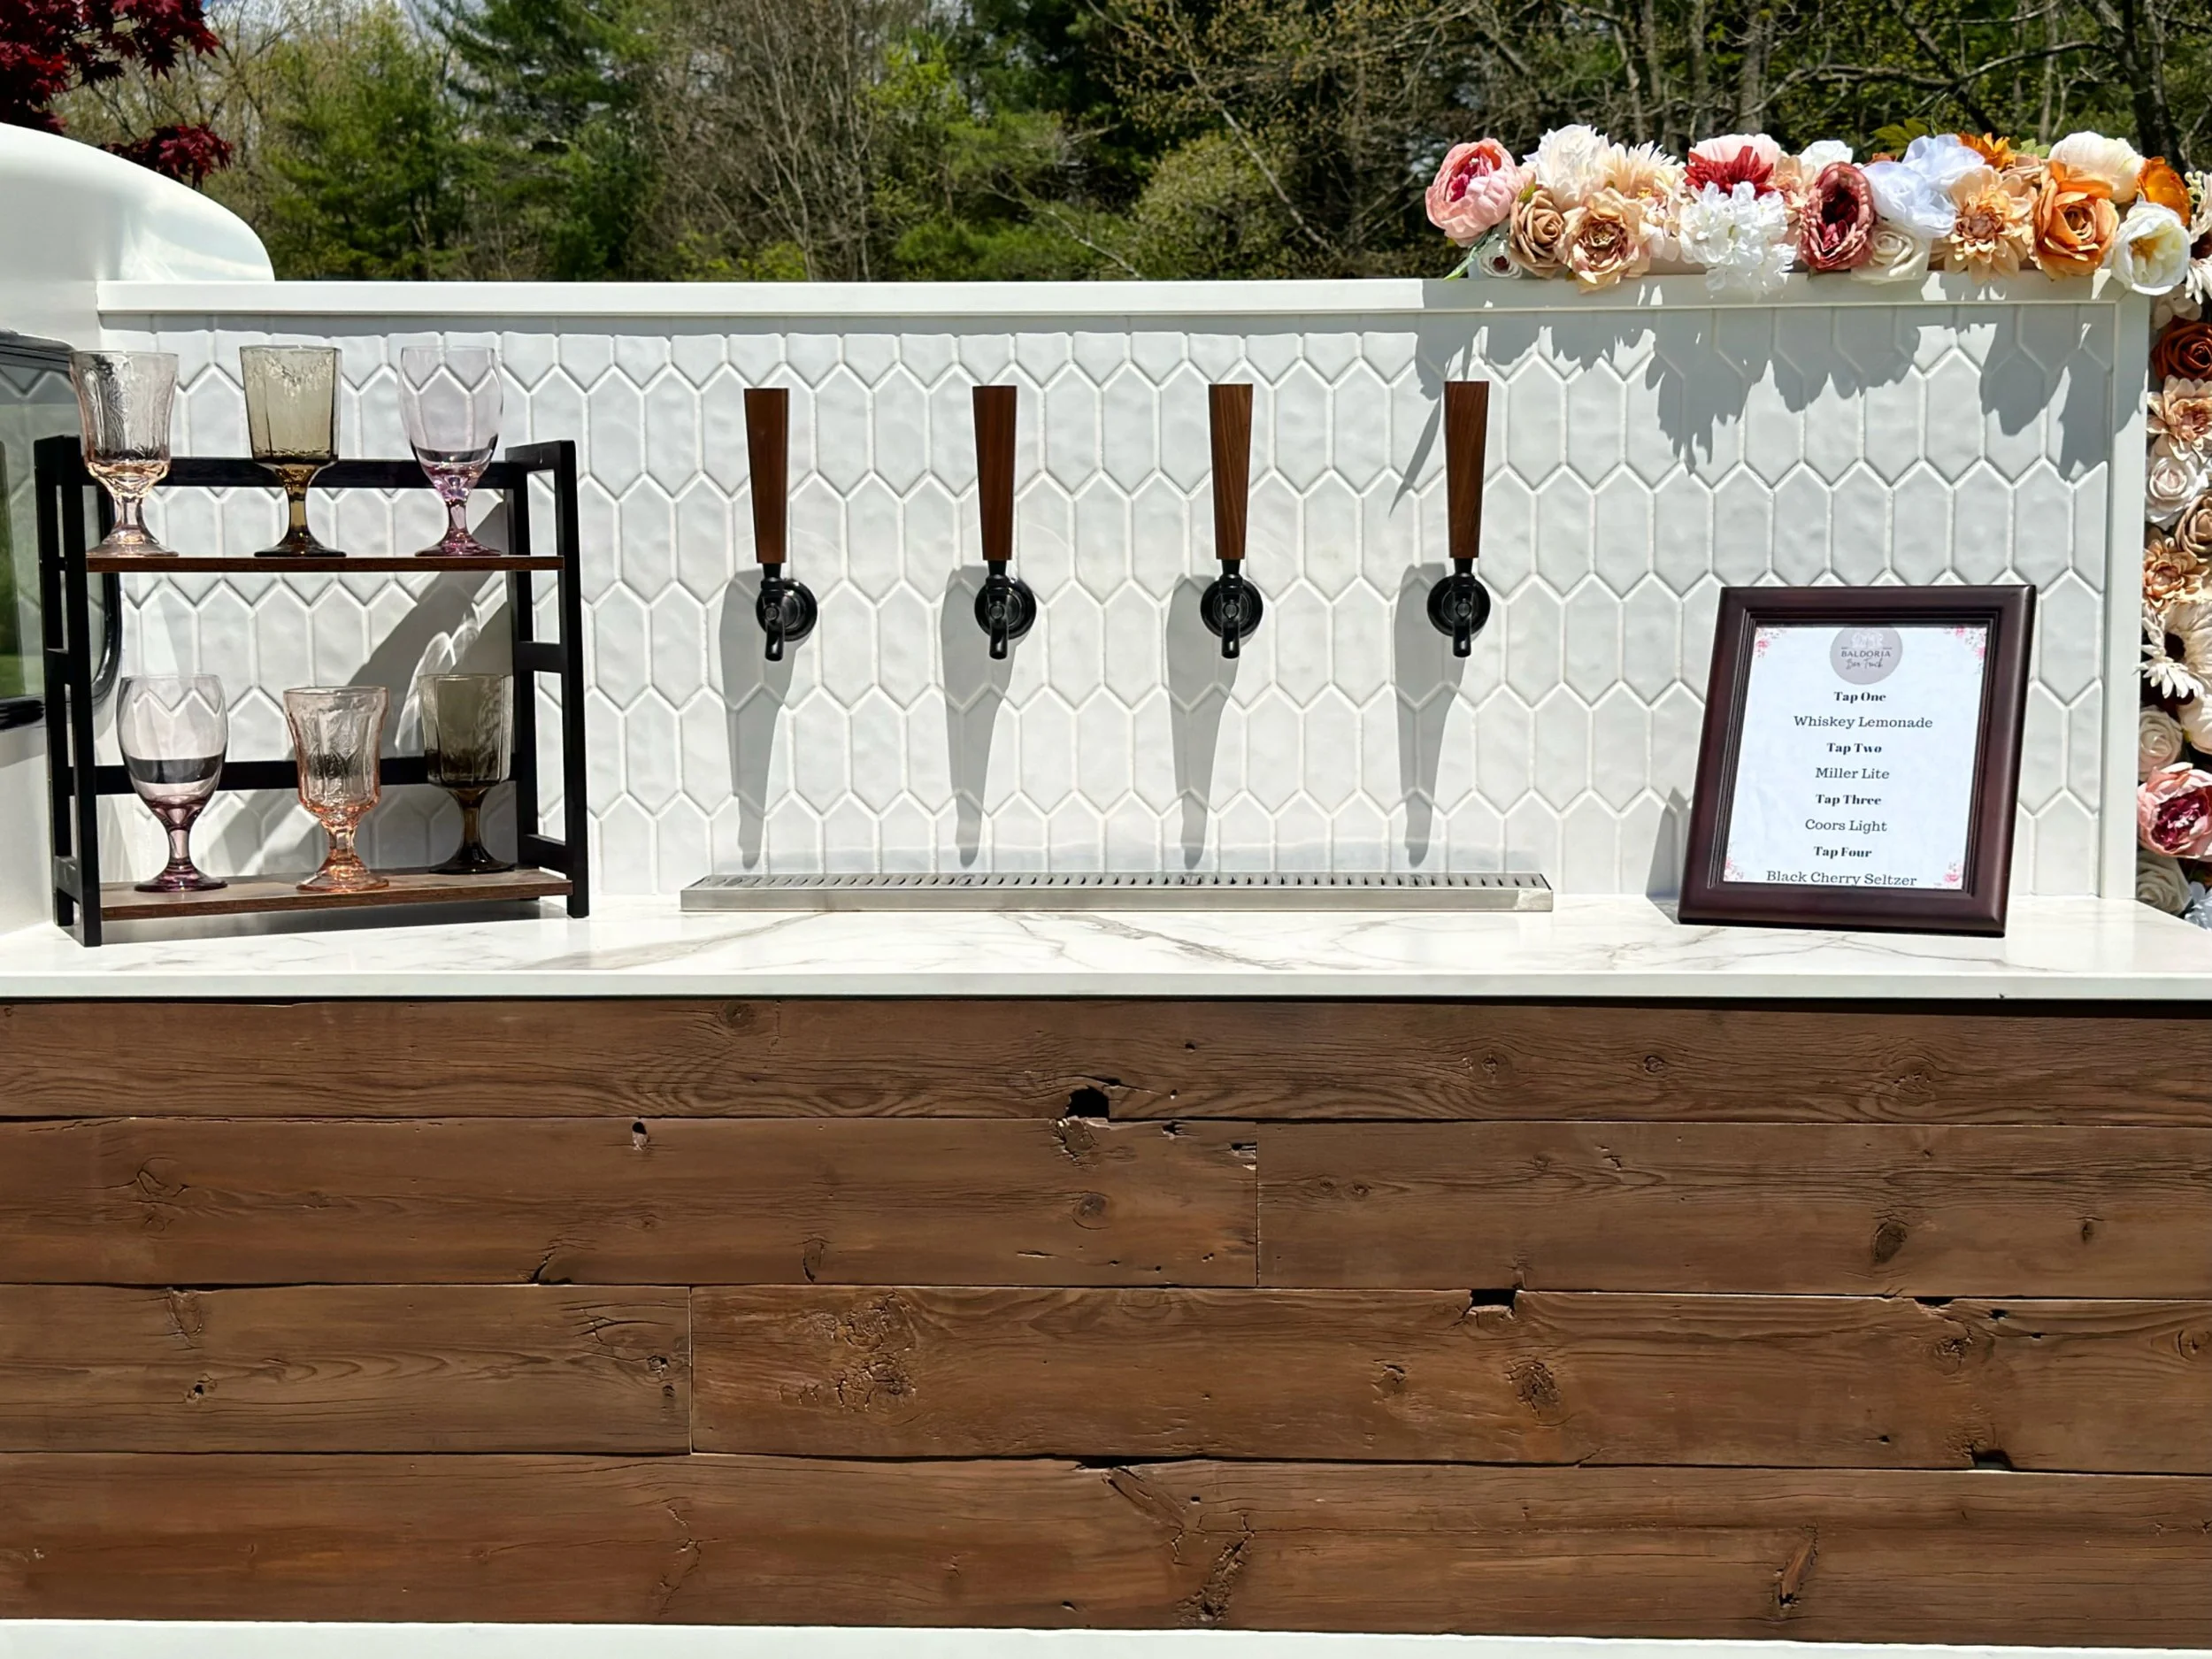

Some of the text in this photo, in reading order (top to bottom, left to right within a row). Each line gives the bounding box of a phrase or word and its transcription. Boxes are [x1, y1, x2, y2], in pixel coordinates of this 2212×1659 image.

[1840, 649, 1892, 658] BALDORIA
[1833, 691, 1886, 704] Tap One
[1793, 715, 1933, 730] Whiskey Lemonade
[1826, 742, 1883, 756] Tap Two
[1815, 767, 1890, 780] Miller Lite
[1816, 794, 1882, 807] Tap Three
[1805, 818, 1887, 833] Coors Light
[1813, 846, 1872, 859] Tap Four
[1766, 871, 1917, 887] Black Cherry Seltzer
